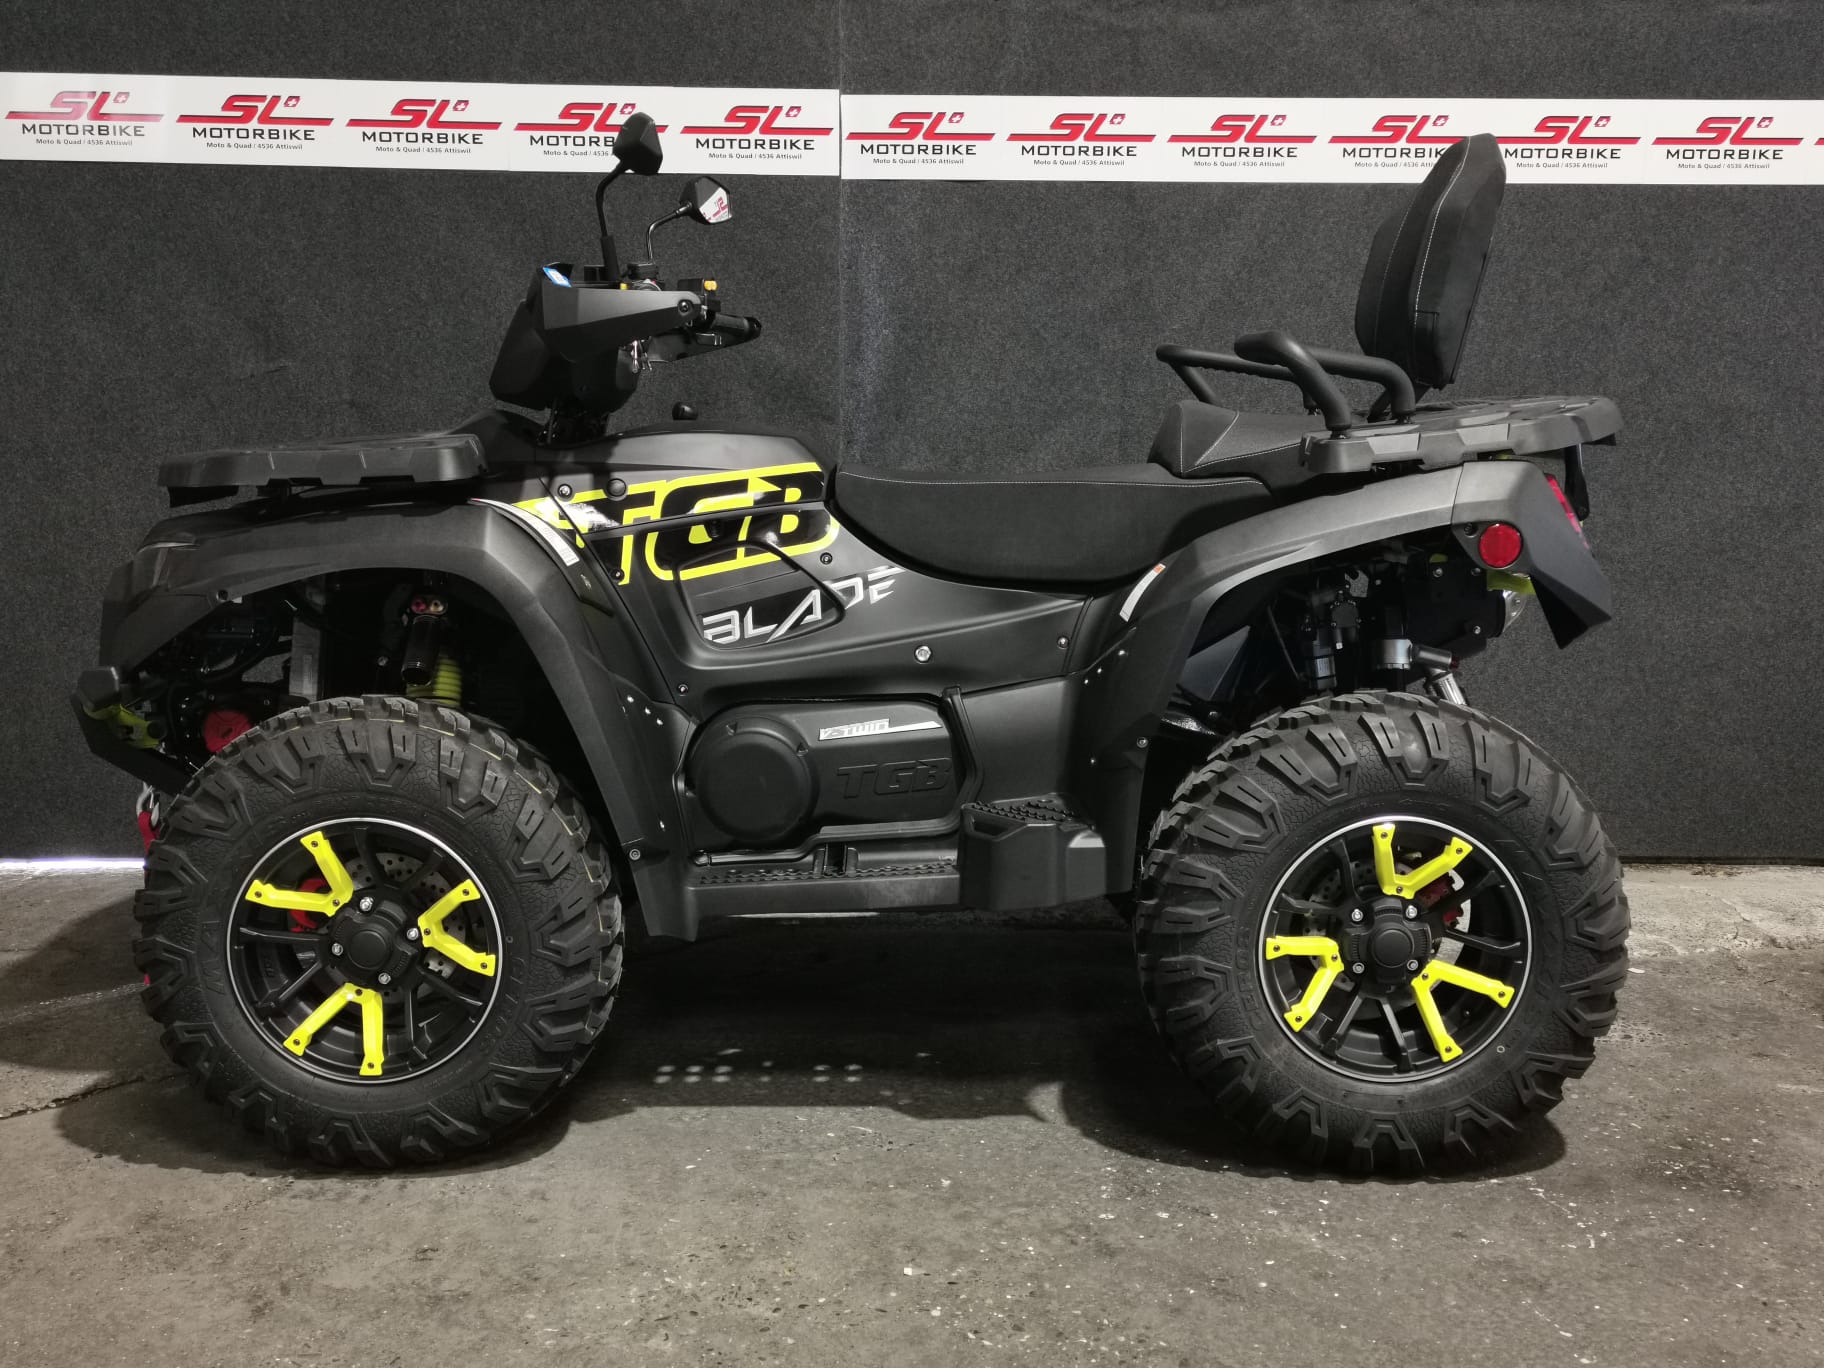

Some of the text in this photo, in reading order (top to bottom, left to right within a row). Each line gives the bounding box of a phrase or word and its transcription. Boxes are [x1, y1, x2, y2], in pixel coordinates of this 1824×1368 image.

[22, 123, 145, 137] MOTORBIKE
[192, 127, 316, 140] MOTORBIKE
[35, 137, 54, 145] Moto
[63, 138, 82, 146] Quad
[361, 131, 484, 145] MOTORBIKE
[529, 135, 615, 147] MOTORB
[206, 141, 225, 149] Moto
[233, 142, 252, 150] Quad
[375, 145, 394, 153] Moto
[402, 146, 421, 154] Quad
[695, 138, 815, 150] MOTORBIKE
[860, 144, 977, 155] MOTORBIKE
[543, 149, 562, 157] Moto
[570, 150, 588, 158] Quad
[1021, 145, 1137, 157] MOTORBIKE
[1181, 147, 1298, 158] MOTORBIKE
[1342, 147, 1446, 159] MOTORBIK
[1504, 148, 1622, 159] MOTORBIKE
[1666, 149, 1784, 160] MOTORBIKE
[898, 157, 916, 165] Quad
[1033, 158, 1051, 166] Moto
[1059, 159, 1077, 167] Quad
[1219, 160, 1237, 168] Quad
[1380, 161, 1398, 169] Quad
[1542, 162, 1560, 170] Quad
[702, 565, 906, 645] BLADE
[837, 757, 950, 800] TGB
